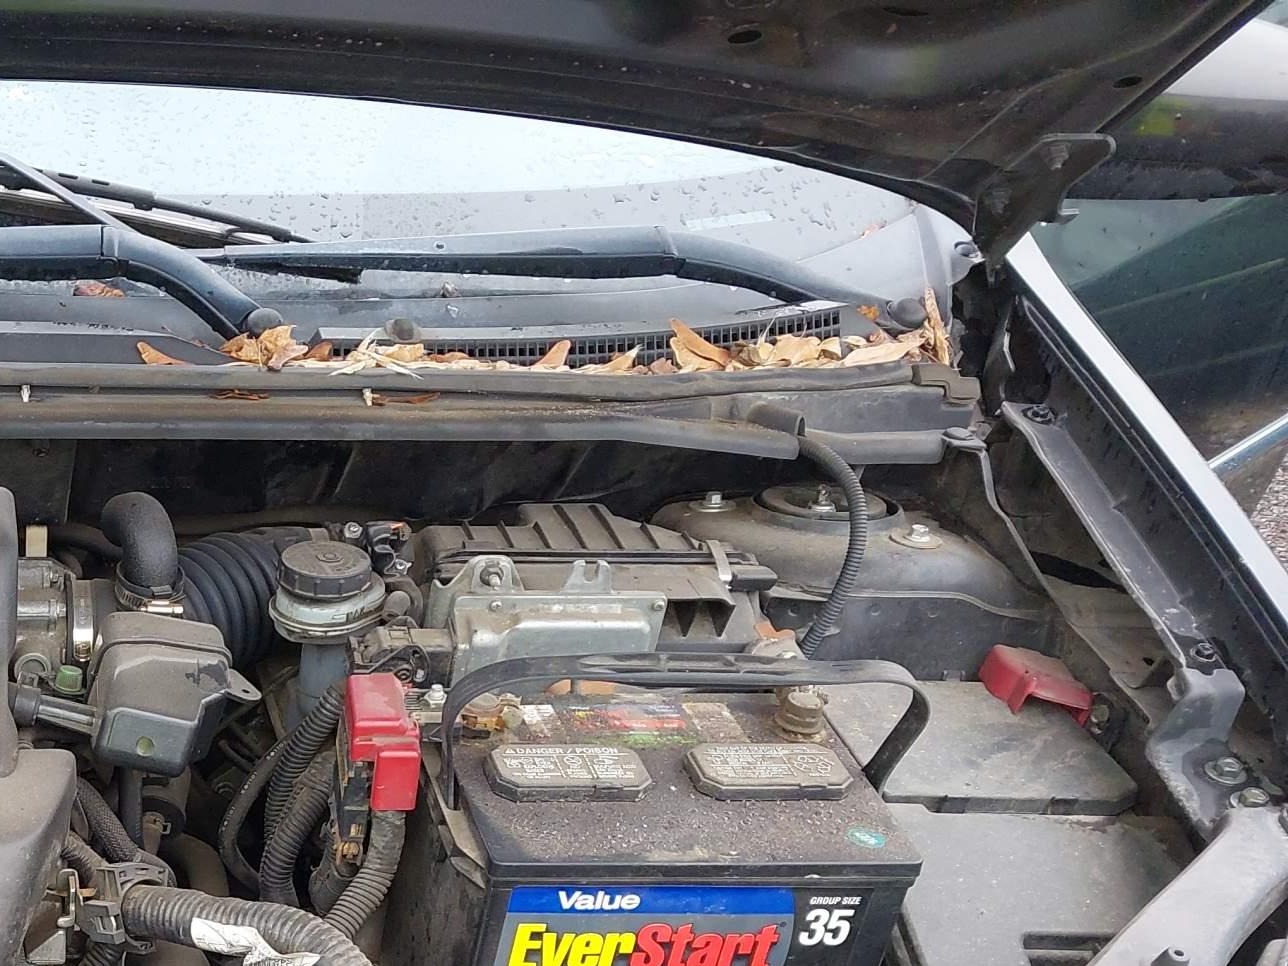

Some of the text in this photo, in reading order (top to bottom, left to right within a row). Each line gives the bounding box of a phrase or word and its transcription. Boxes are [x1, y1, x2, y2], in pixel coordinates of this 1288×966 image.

[558, 890, 641, 911] Value
[809, 896, 863, 905] GROUP SIZE
[798, 908, 855, 946] 35
